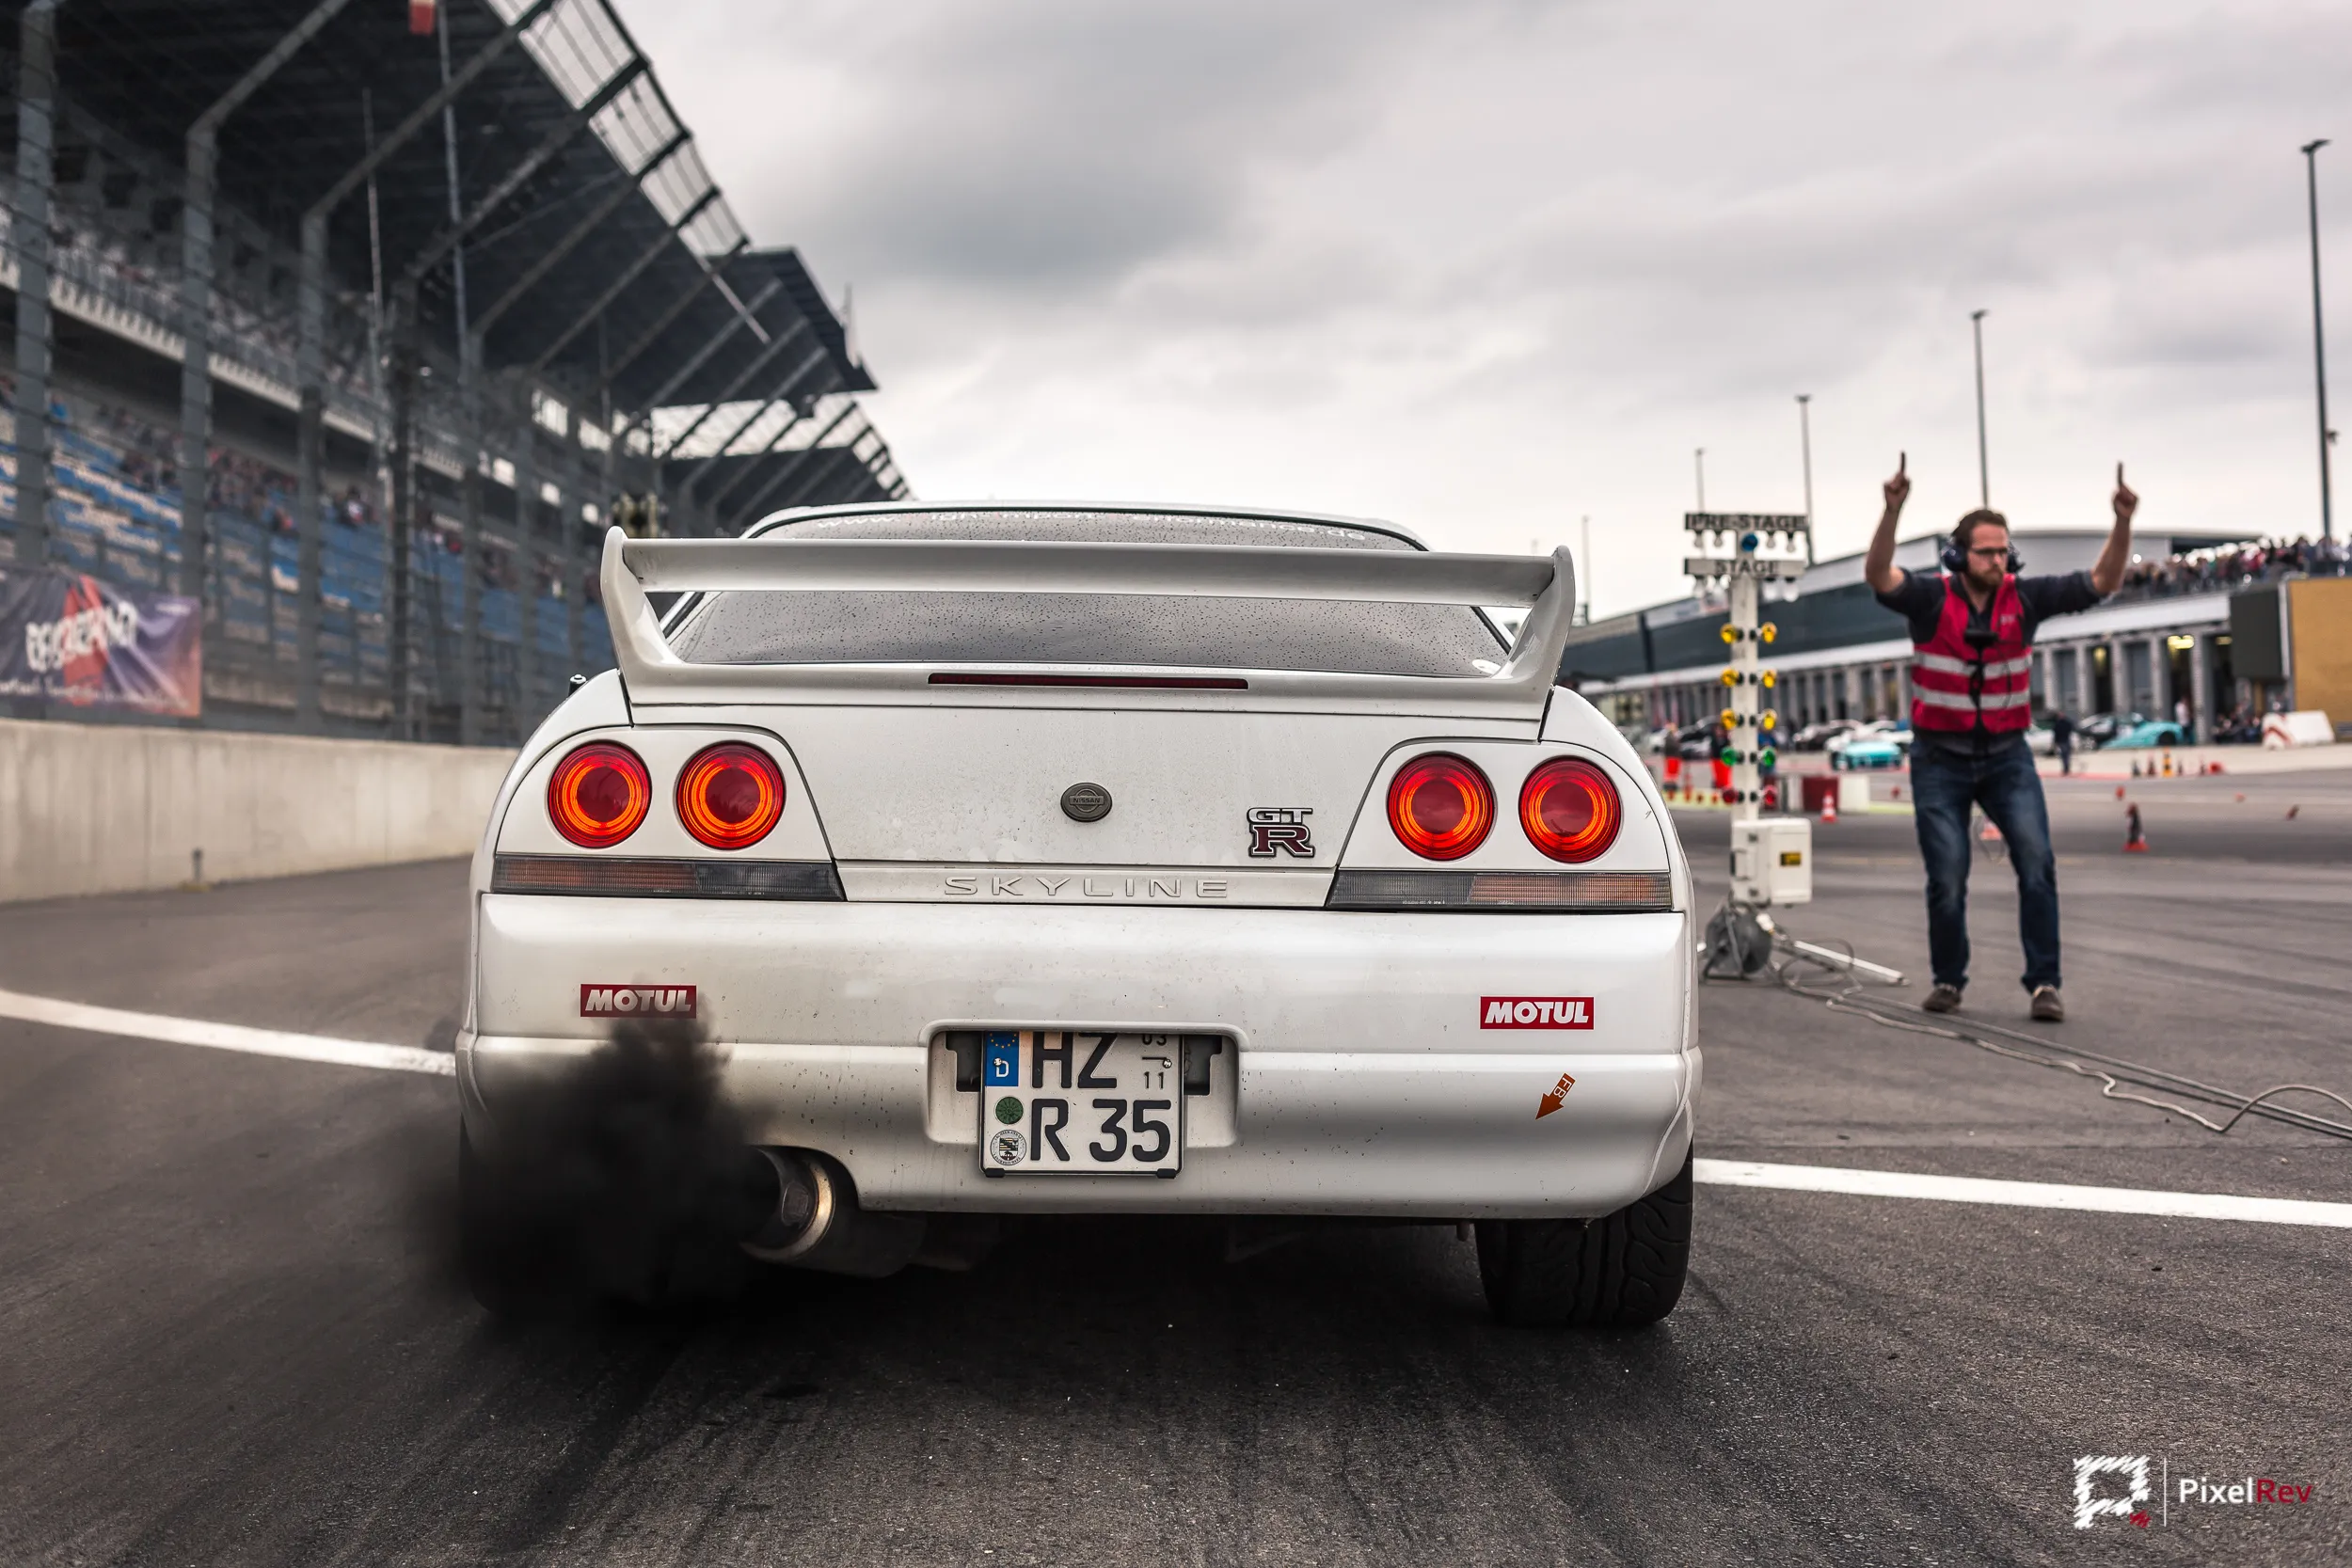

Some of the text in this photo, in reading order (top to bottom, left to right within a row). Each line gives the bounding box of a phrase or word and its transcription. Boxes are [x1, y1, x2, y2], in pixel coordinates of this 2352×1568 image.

[1715, 560, 1779, 576] STAGE
[1247, 807, 1313, 823] GT
[1248, 824, 1315, 858] R
[944, 876, 1229, 898] SKYLINE
[584, 989, 691, 1012] MOTUL
[1484, 1000, 1589, 1024] MOTUL
[995, 1059, 1009, 1078] D
[1031, 1031, 1118, 1088] HZ
[1143, 1070, 1165, 1089] 11
[1553, 1077, 1573, 1099] FB
[1030, 1099, 1172, 1163] R 35
